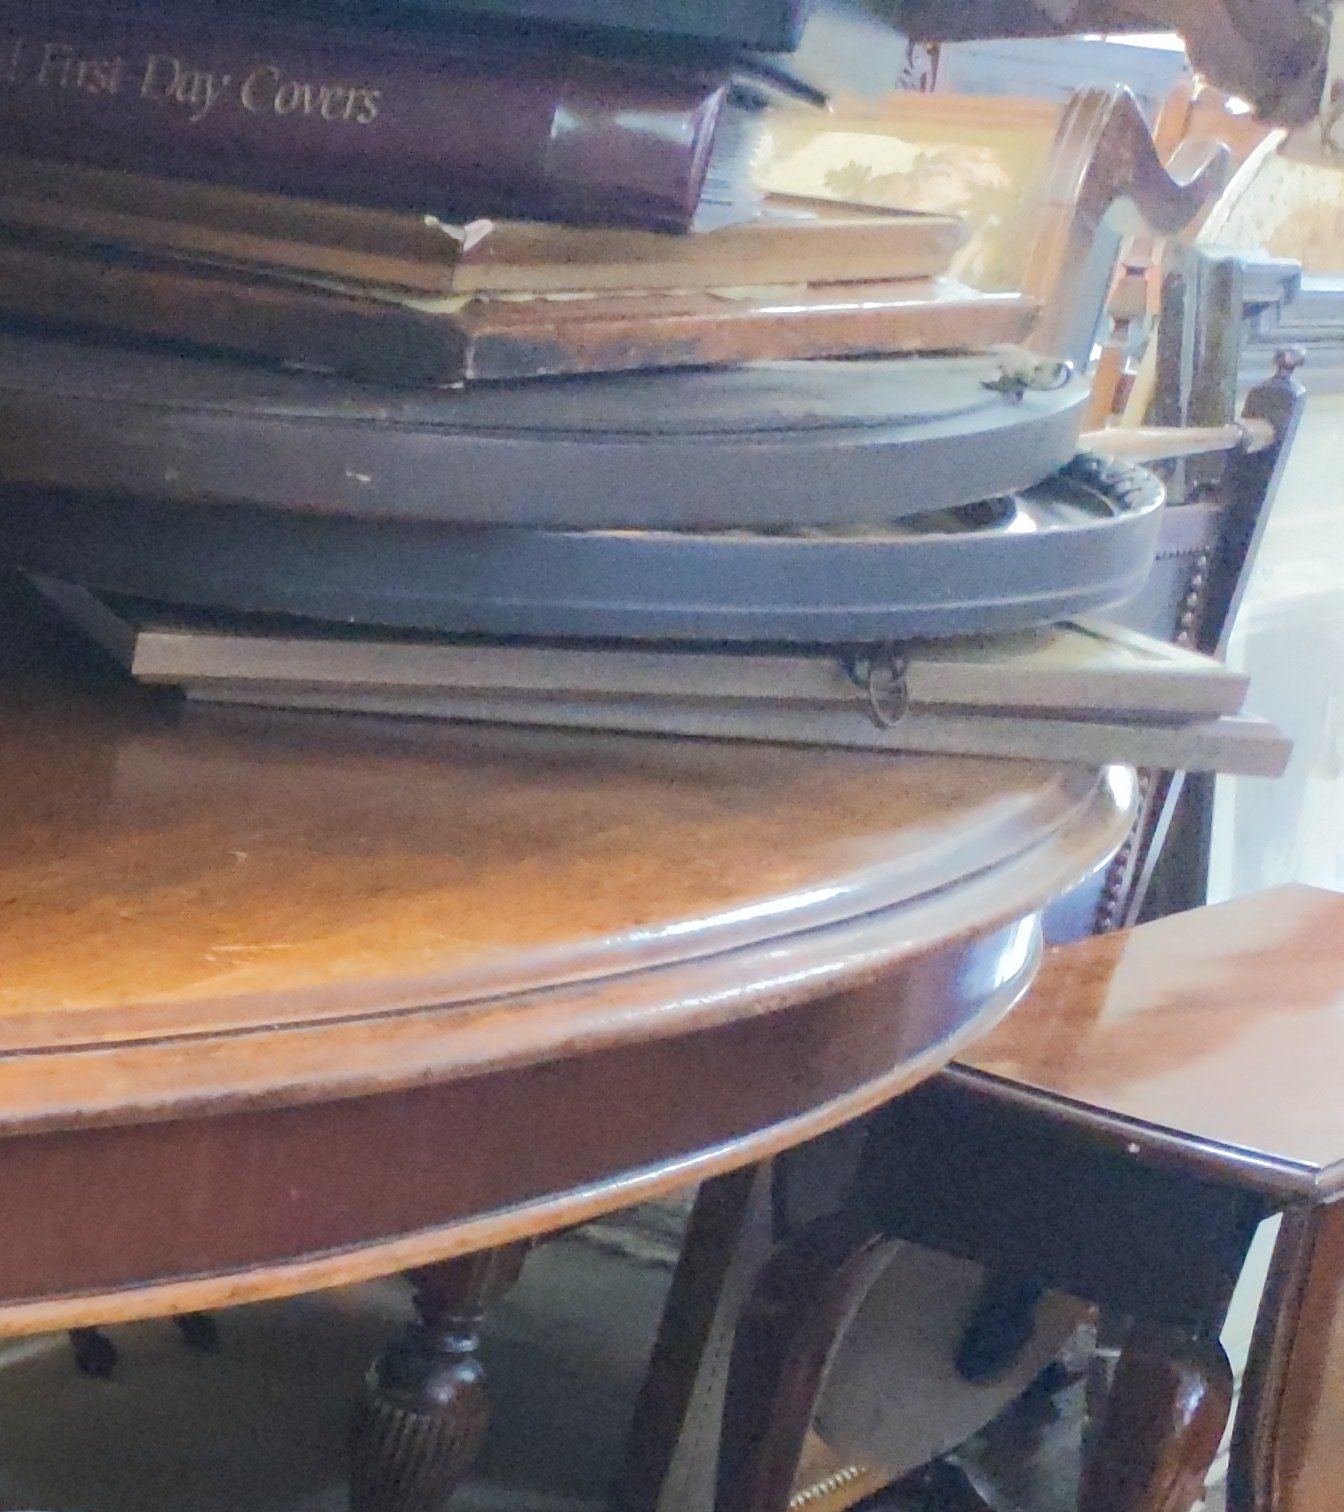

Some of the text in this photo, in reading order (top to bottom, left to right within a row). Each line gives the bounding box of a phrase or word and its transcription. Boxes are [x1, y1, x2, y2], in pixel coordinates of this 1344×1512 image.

[38, 43, 121, 94] First
[140, 53, 229, 122] Day
[240, 64, 382, 125] Covers
